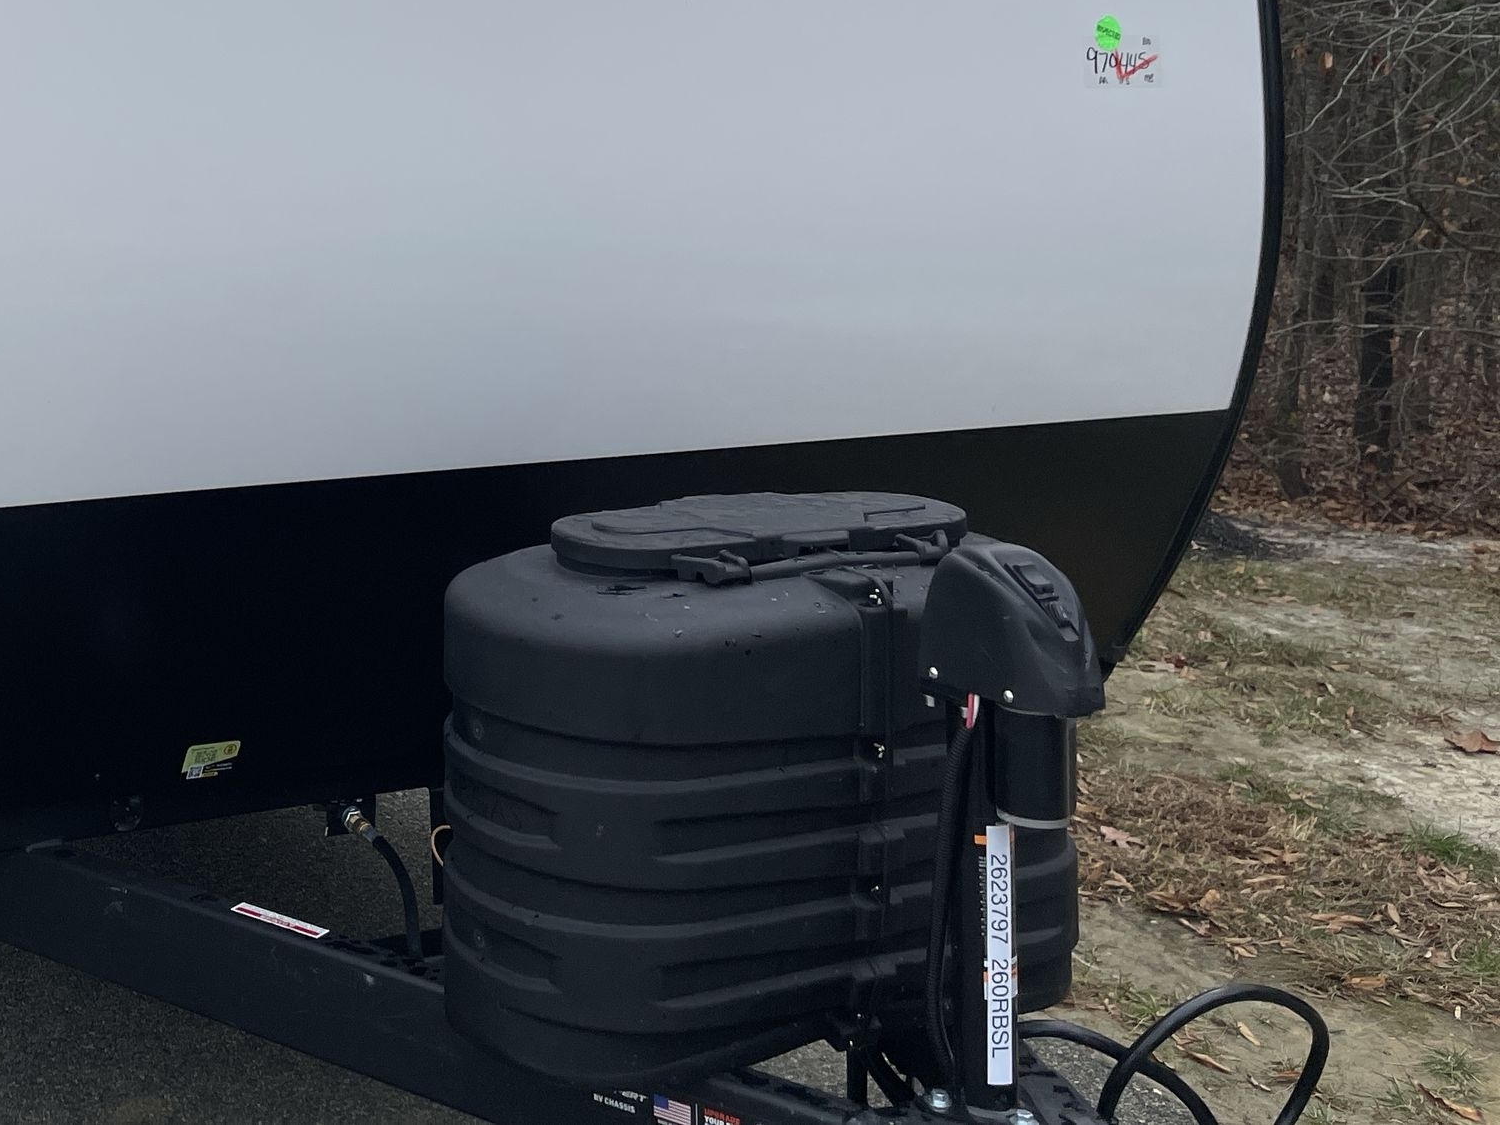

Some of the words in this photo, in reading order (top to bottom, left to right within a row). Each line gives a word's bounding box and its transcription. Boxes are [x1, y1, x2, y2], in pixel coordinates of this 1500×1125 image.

[990, 854, 1009, 945] 2623797
[991, 959, 1010, 1059] 260RBSL
[604, 1096, 636, 1114] CHASSIS
